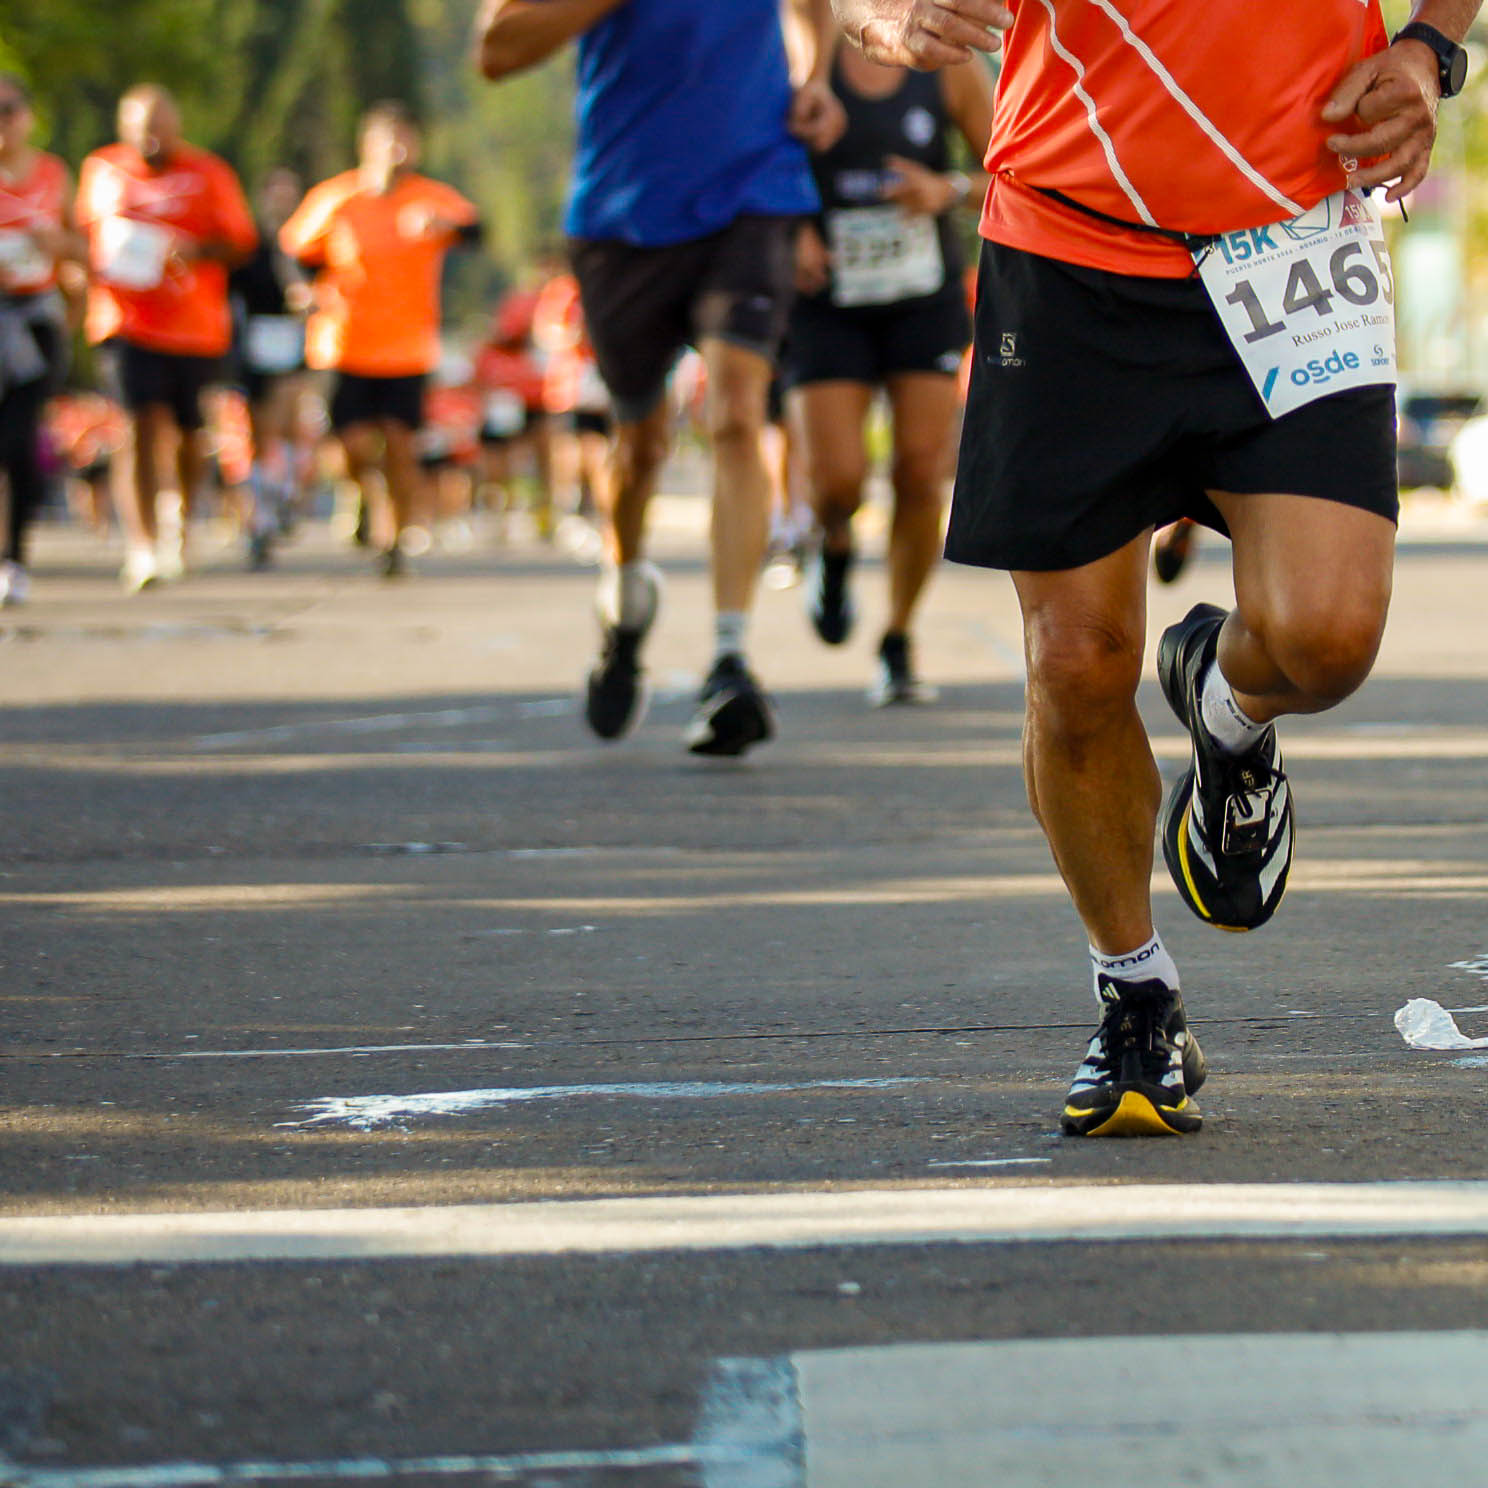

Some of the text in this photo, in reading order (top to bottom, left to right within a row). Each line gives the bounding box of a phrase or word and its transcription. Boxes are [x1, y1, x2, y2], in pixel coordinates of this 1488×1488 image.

[1214, 223, 1279, 265] 15K
[1291, 327, 1332, 347] Russo
[1333, 318, 1360, 333] Jose
[1290, 348, 1360, 386] osde
[1091, 941, 1160, 969] omon
